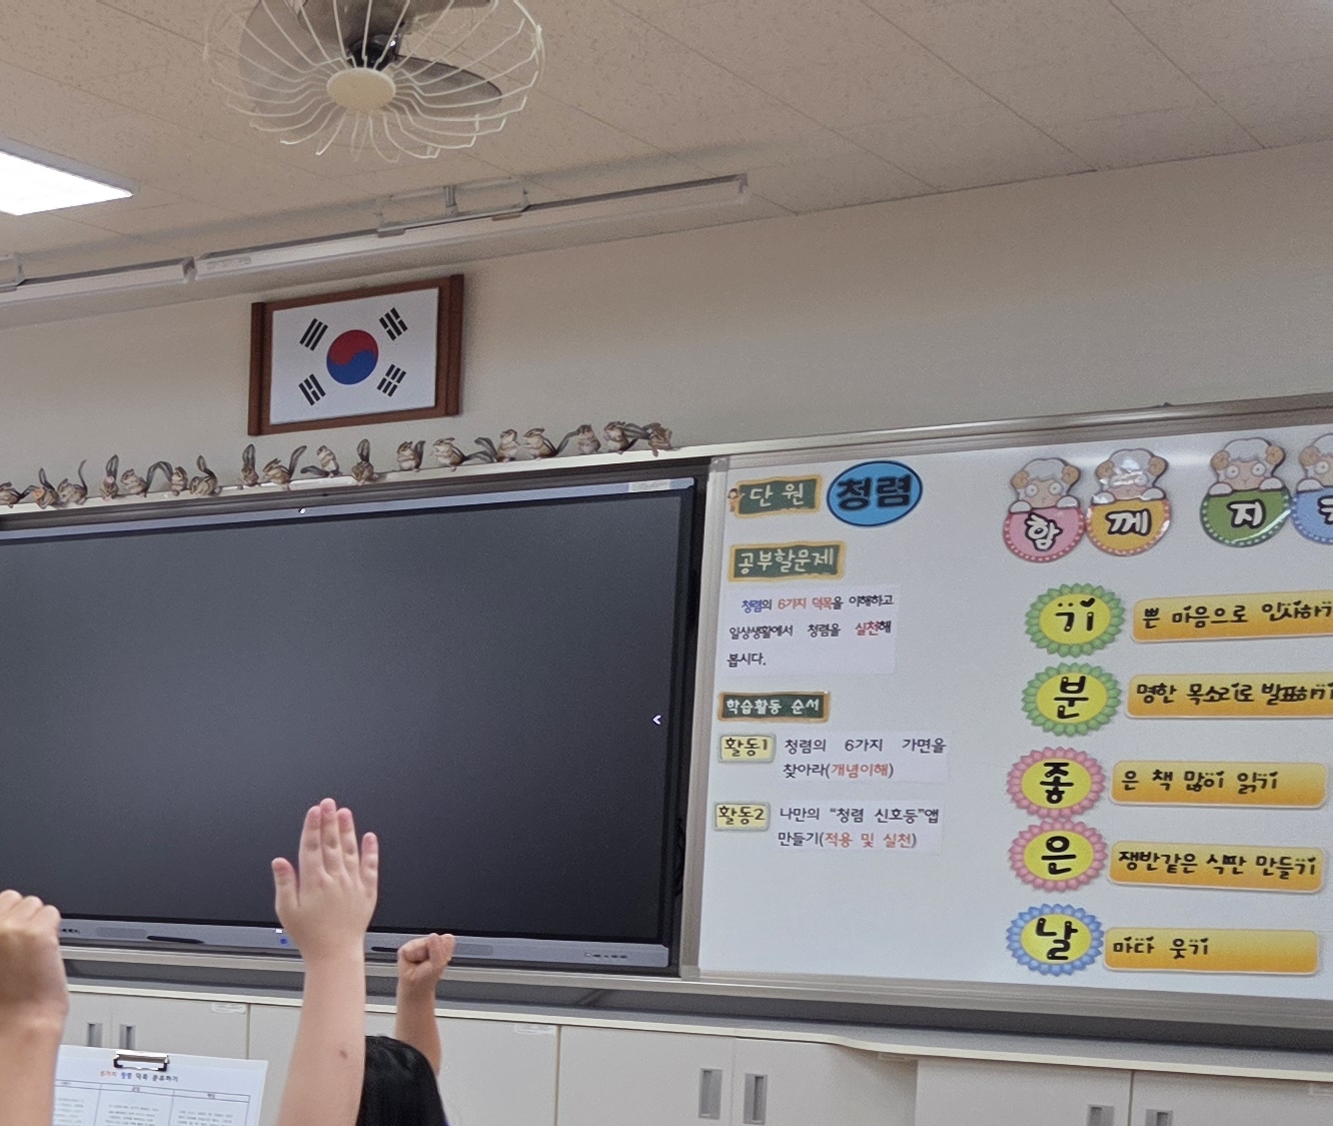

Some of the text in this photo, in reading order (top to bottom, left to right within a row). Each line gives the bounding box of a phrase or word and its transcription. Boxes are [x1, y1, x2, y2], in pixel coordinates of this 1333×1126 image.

[836, 474, 913, 512] 청렴
[738, 547, 834, 575] 공부할문제
[741, 594, 894, 614] 청렴의 6가지 덕목을 이해하고
[1055, 597, 1096, 632] 기
[1142, 607, 1160, 629] 쁜
[1172, 605, 1248, 629] 마음으로
[729, 620, 892, 640] 일상생활에서 청렴을 실천해
[727, 653, 767, 668] 봅시다.
[1053, 675, 1089, 719] 분
[1137, 683, 1177, 704] 명한
[1187, 683, 1255, 706] 목소리로
[726, 698, 820, 715] 학습활동 순서
[724, 737, 769, 757] 활동1
[784, 737, 947, 755] 청렴의 6가지 가면을
[782, 763, 894, 779] 찾아라(개념이해)
[1121, 769, 1278, 795] 은 책 많이 읽기
[1040, 761, 1074, 805] 좋
[718, 805, 766, 826] 활동2
[780, 807, 820, 823] 나만의
[778, 832, 917, 849] 만들기(적용 및 실천)
[1041, 836, 1077, 876] 은
[1118, 851, 1317, 880] 쟁반같은 식판 만들기
[1035, 917, 1079, 962] 날
[1113, 936, 1209, 960] 마다 웃기
